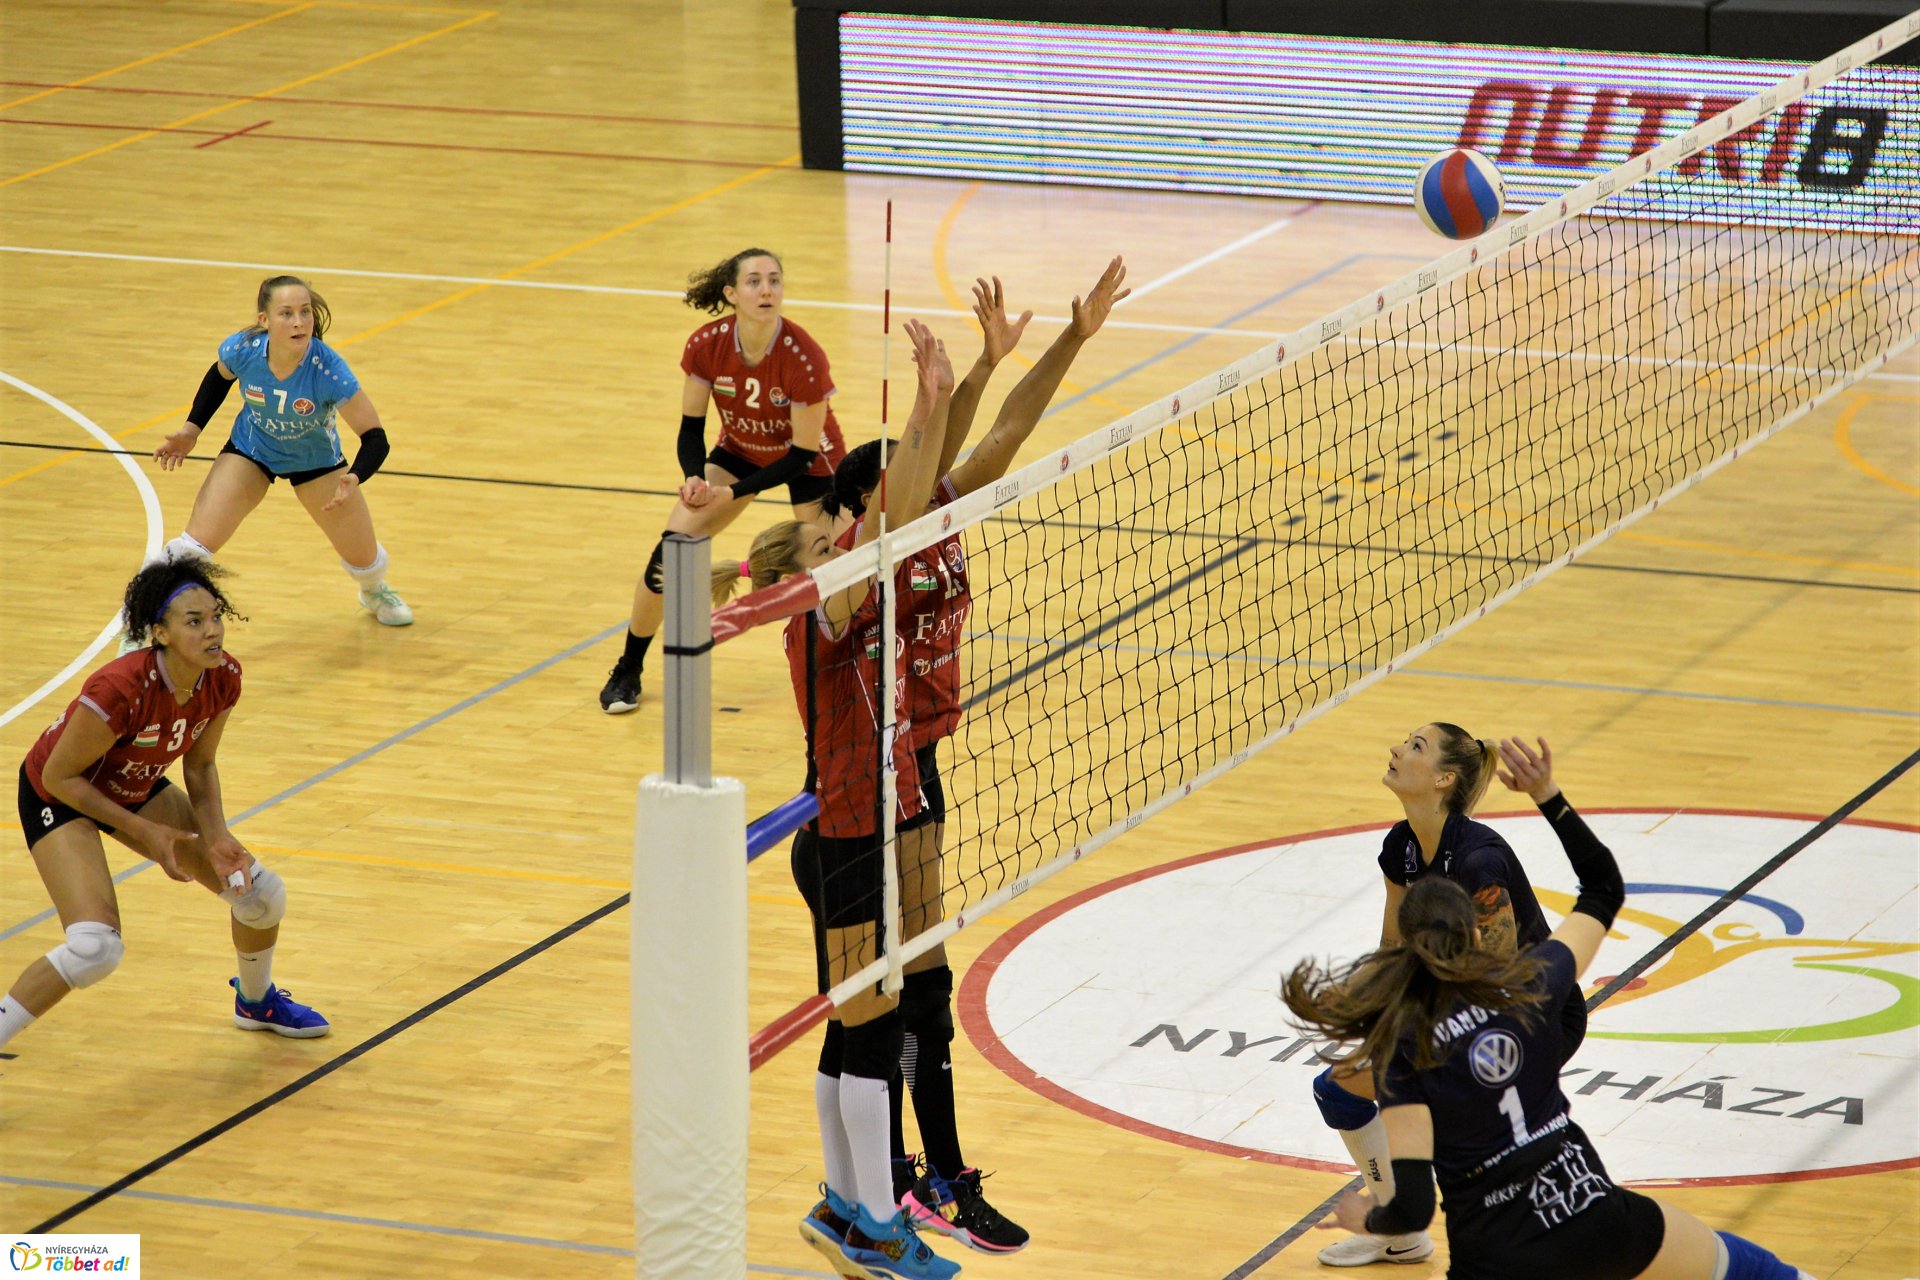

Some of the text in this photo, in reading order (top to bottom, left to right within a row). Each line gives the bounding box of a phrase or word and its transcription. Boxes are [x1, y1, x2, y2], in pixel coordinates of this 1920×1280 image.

[1418, 270, 1437, 287] FATUM
[1321, 318, 1341, 337] FATUM
[1219, 370, 1240, 390] FATUM
[273, 389, 288, 414] 7
[745, 377, 761, 409] 2
[1110, 424, 1132, 444] FATUM
[995, 481, 1019, 502] FATUM
[166, 718, 188, 752] 3
[41, 807, 54, 827] 3
[1125, 812, 1143, 828] FATUM
[1011, 879, 1029, 896] FATUM
[1498, 1086, 1532, 1148] 1
